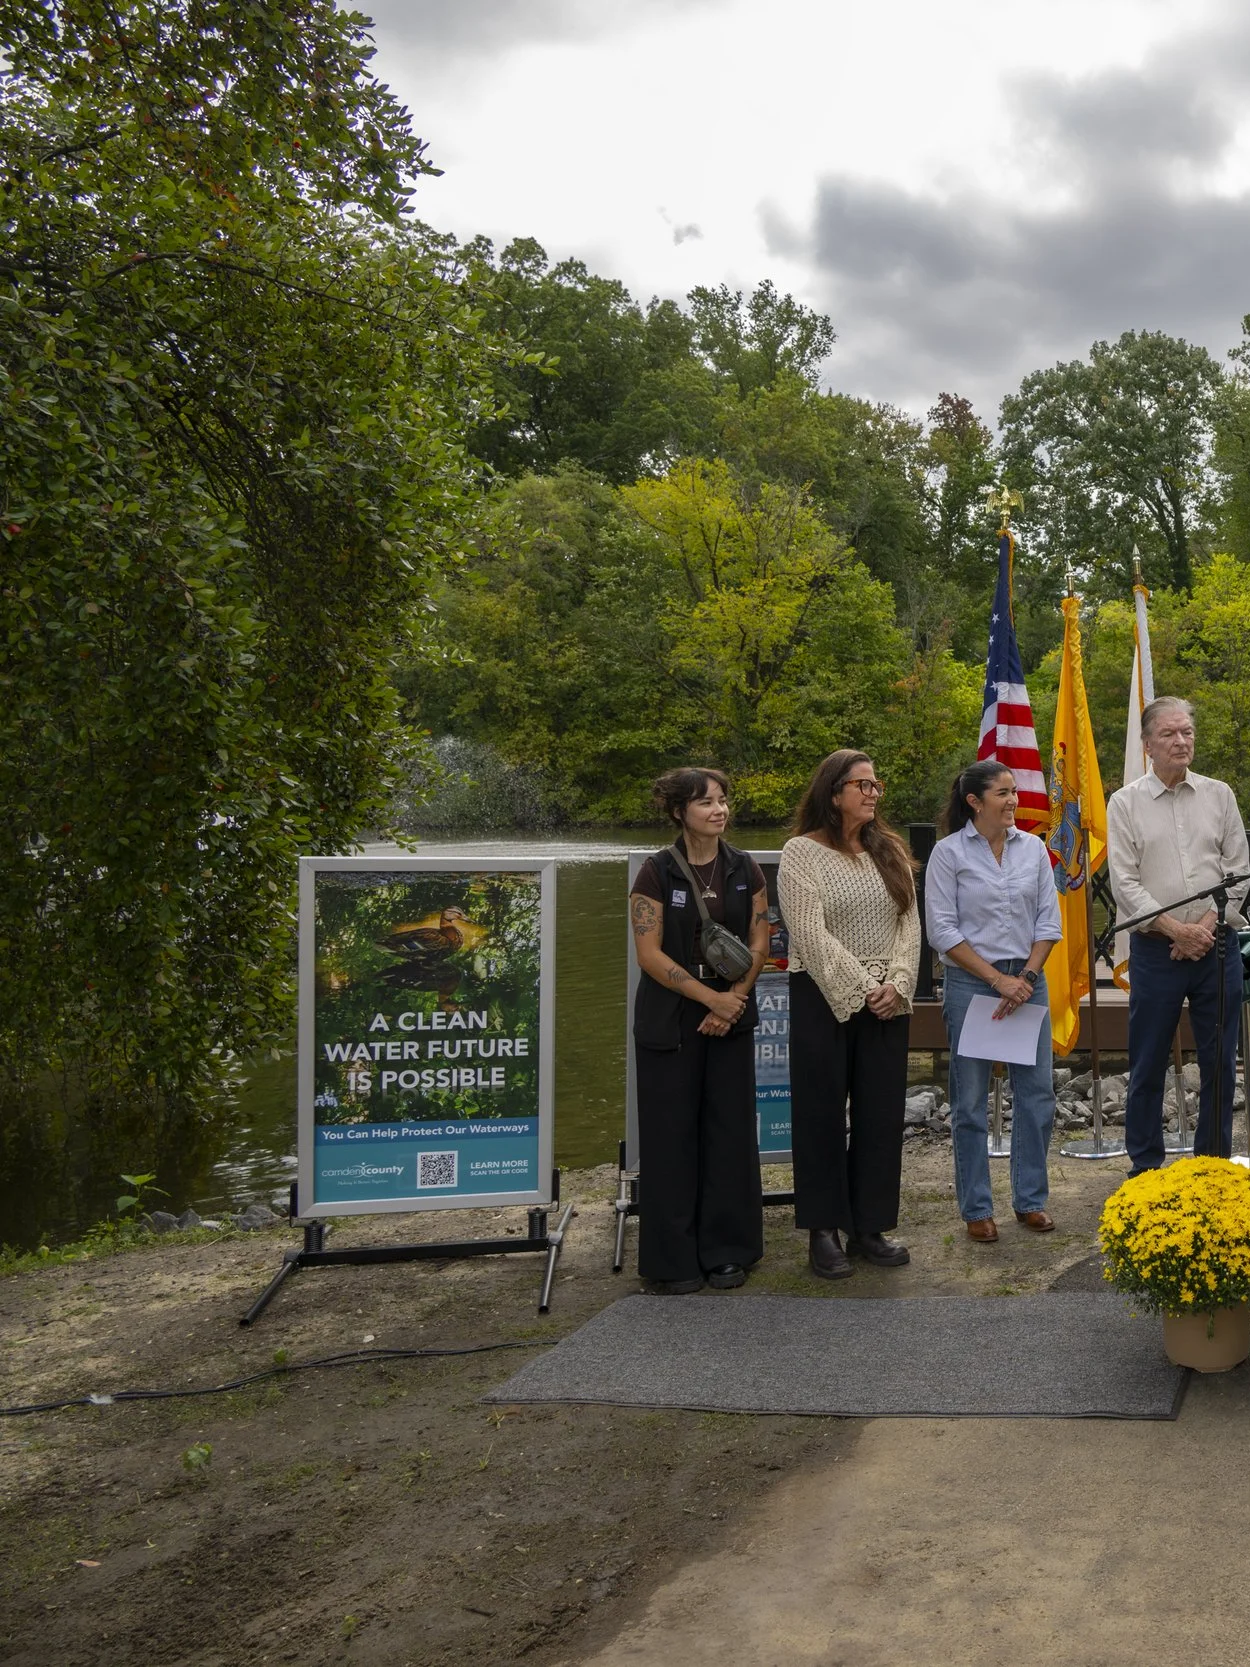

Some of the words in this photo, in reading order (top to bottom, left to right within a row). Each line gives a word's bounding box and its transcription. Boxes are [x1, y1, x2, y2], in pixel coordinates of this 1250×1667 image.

[756, 996, 790, 1011] AT
[369, 1013, 390, 1032] A
[399, 1011, 488, 1031] CLEAN
[324, 1041, 420, 1062] WATER
[428, 1038, 529, 1059] FUTURE
[350, 1072, 372, 1091] IS
[382, 1067, 506, 1089] POSSIBLE
[322, 1131, 343, 1140] You
[347, 1130, 368, 1139] Can
[372, 1128, 398, 1139] Help
[402, 1127, 442, 1136] Protect
[446, 1126, 466, 1134] Our
[470, 1124, 529, 1133] Waterways
[321, 1166, 360, 1176] camden
[366, 1165, 404, 1175] county
[470, 1161, 500, 1169] LEARN
[502, 1160, 528, 1168] MORE
